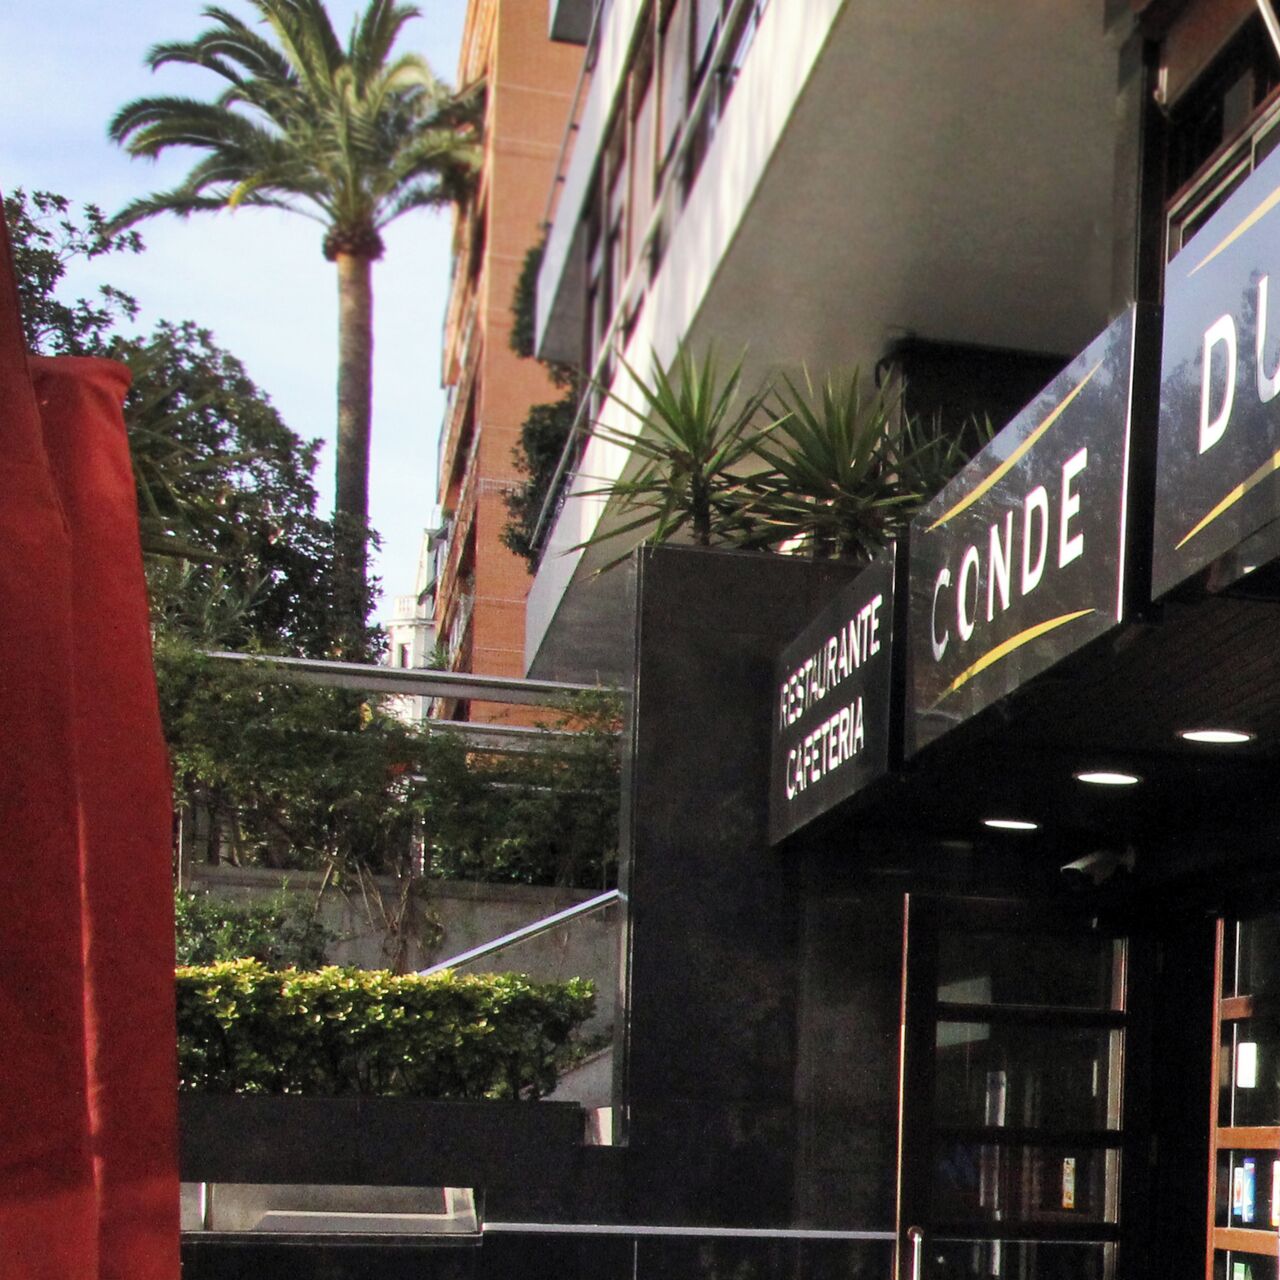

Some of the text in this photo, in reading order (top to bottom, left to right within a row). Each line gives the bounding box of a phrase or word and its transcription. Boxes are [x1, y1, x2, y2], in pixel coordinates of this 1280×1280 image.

[931, 447, 1088, 662] CONDE
[780, 594, 883, 731] RESTAURANTE
[786, 696, 865, 800] CAFETERIA
